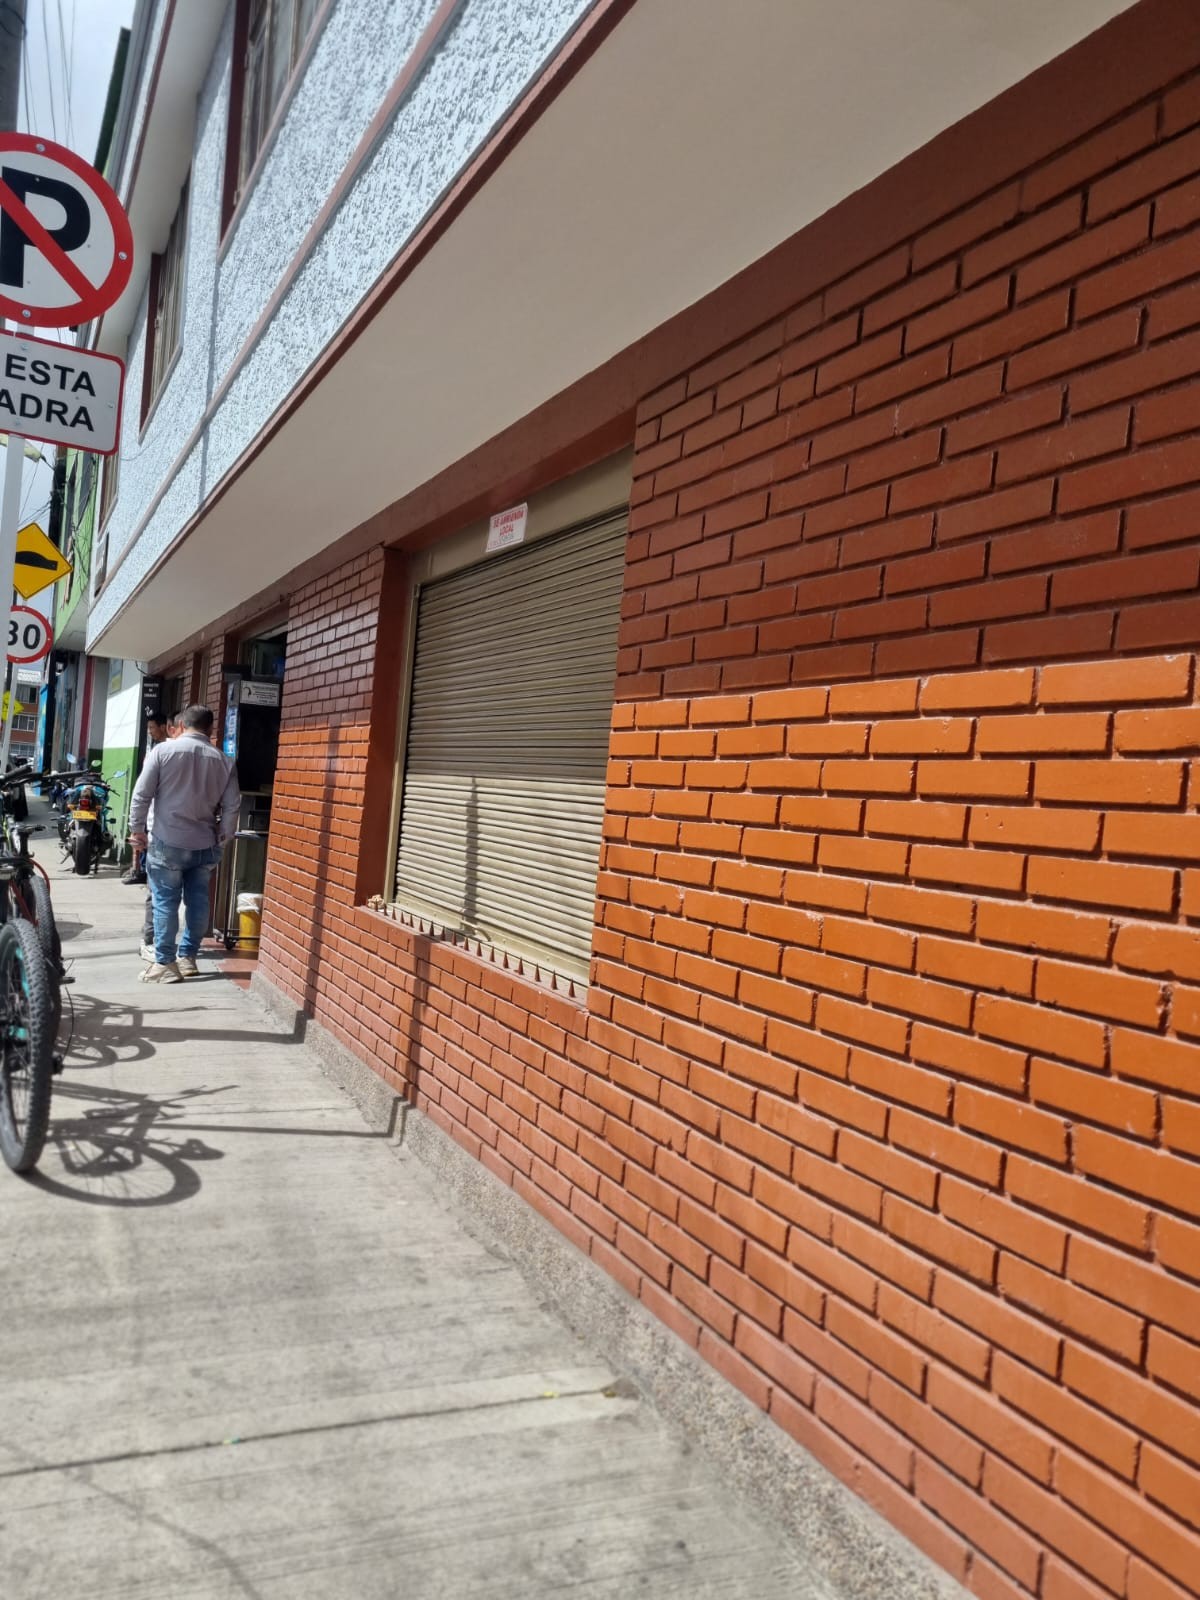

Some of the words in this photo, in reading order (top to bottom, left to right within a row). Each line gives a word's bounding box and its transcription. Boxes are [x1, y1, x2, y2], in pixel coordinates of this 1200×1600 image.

[0, 166, 90, 288] P
[5, 353, 96, 397] ESTA
[0, 382, 94, 432] ADRA
[8, 620, 41, 650] 30
